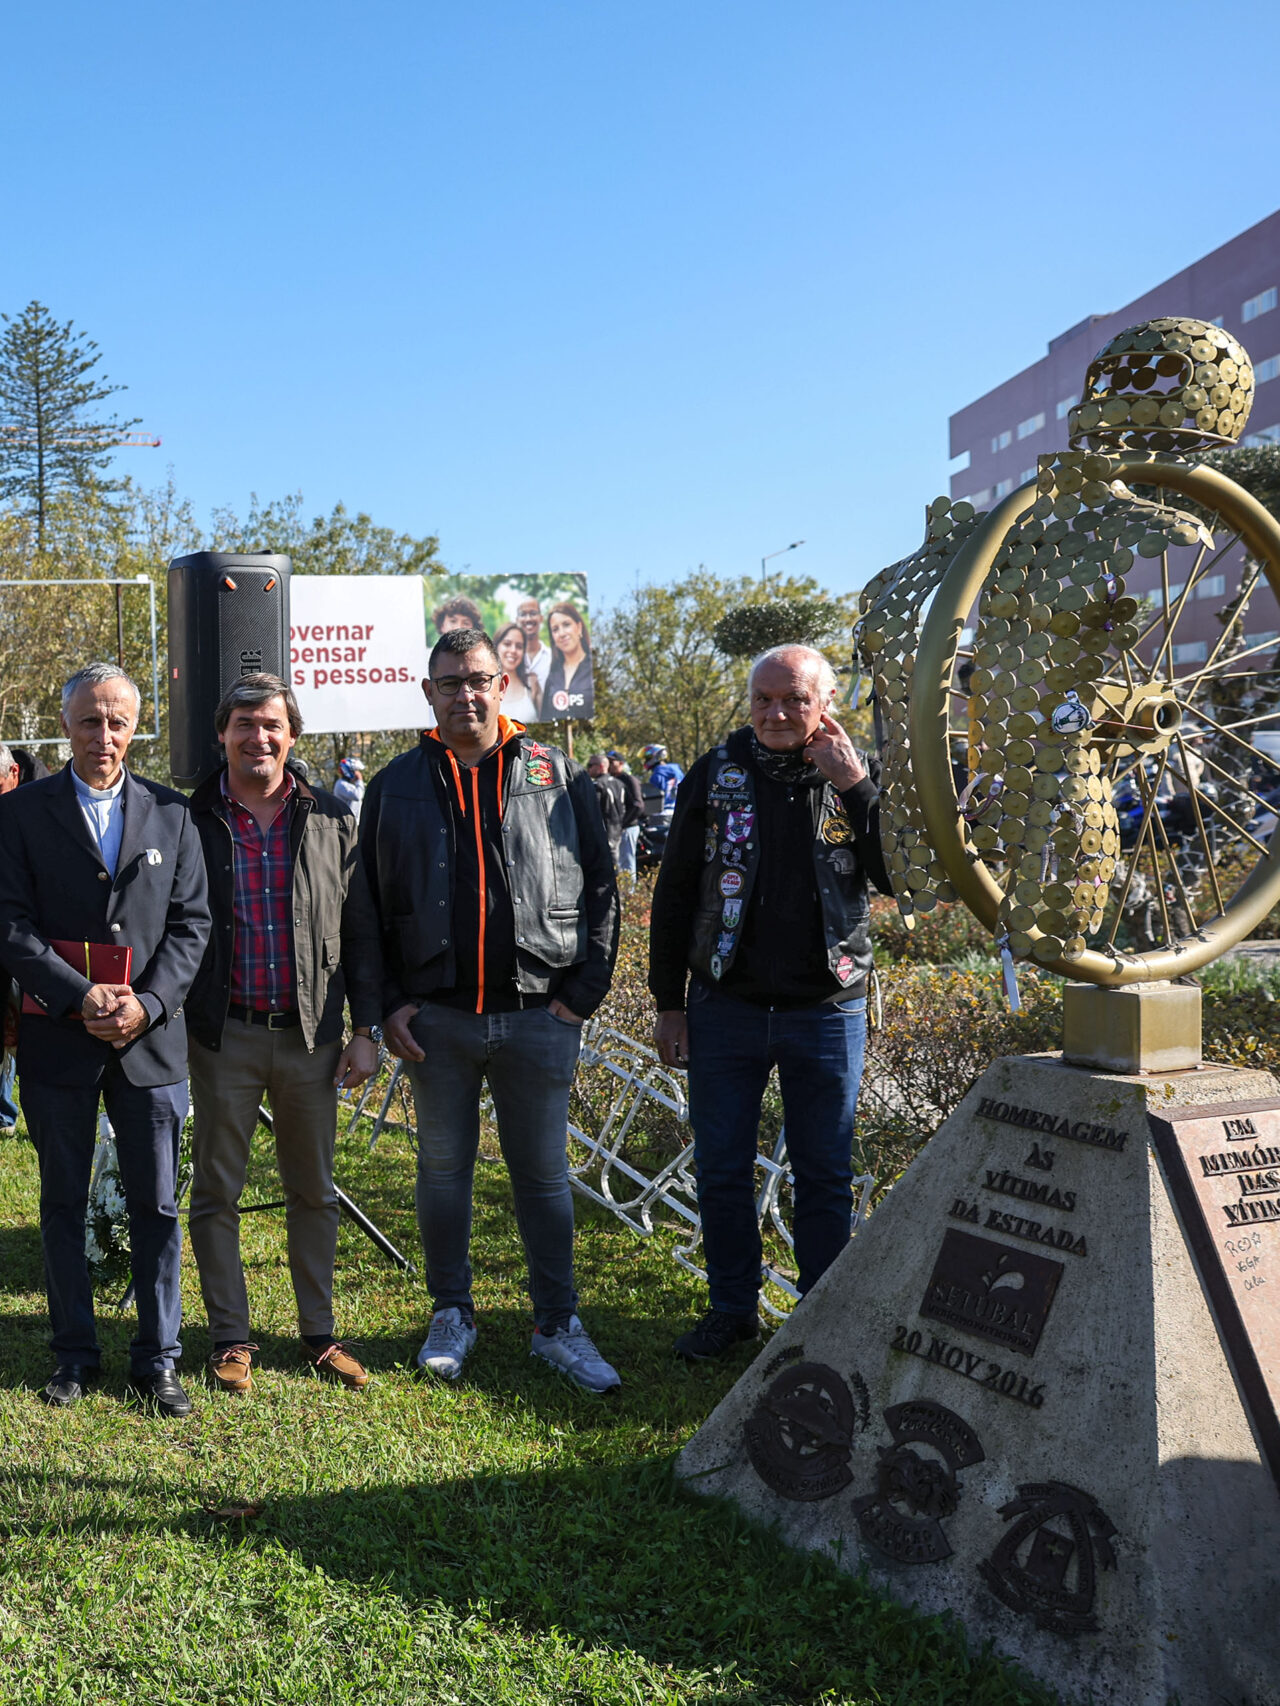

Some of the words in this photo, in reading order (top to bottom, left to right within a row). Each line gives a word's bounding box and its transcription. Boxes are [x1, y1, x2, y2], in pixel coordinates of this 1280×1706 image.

[290, 625, 374, 641] vernar
[314, 667, 416, 689] pessoas.
[569, 693, 585, 706] PS
[975, 1097, 1130, 1152] HOMENAGEM
[1222, 1118, 1259, 1142] EM
[1199, 1143, 1280, 1178] MEMÓR
[982, 1169, 1078, 1213] VÍTIMAS
[1237, 1168, 1280, 1197] DAS
[984, 1208, 1088, 1257] ESTRADA
[890, 1325, 923, 1354] 20
[925, 1336, 985, 1377] NOV
[980, 1363, 1048, 1409] 2016
